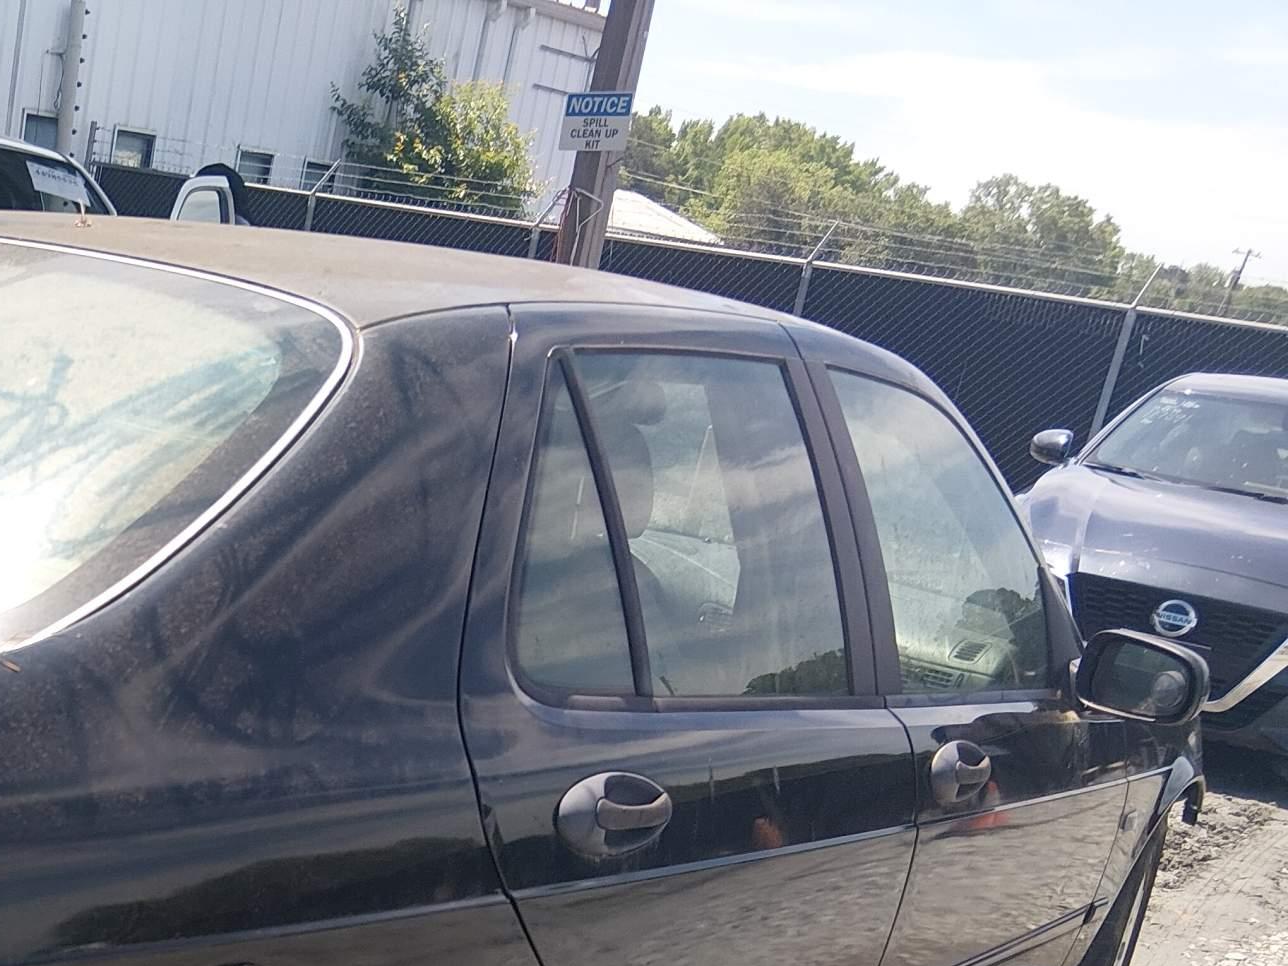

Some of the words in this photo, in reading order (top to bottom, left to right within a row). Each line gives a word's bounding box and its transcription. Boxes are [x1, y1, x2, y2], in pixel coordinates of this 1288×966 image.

[568, 96, 630, 113] NOTICE
[583, 118, 609, 128] SPILL
[570, 129, 602, 139] CLEAN
[605, 129, 619, 139] UP
[584, 140, 601, 150] KIT
[1159, 612, 1192, 625] NISSAN
